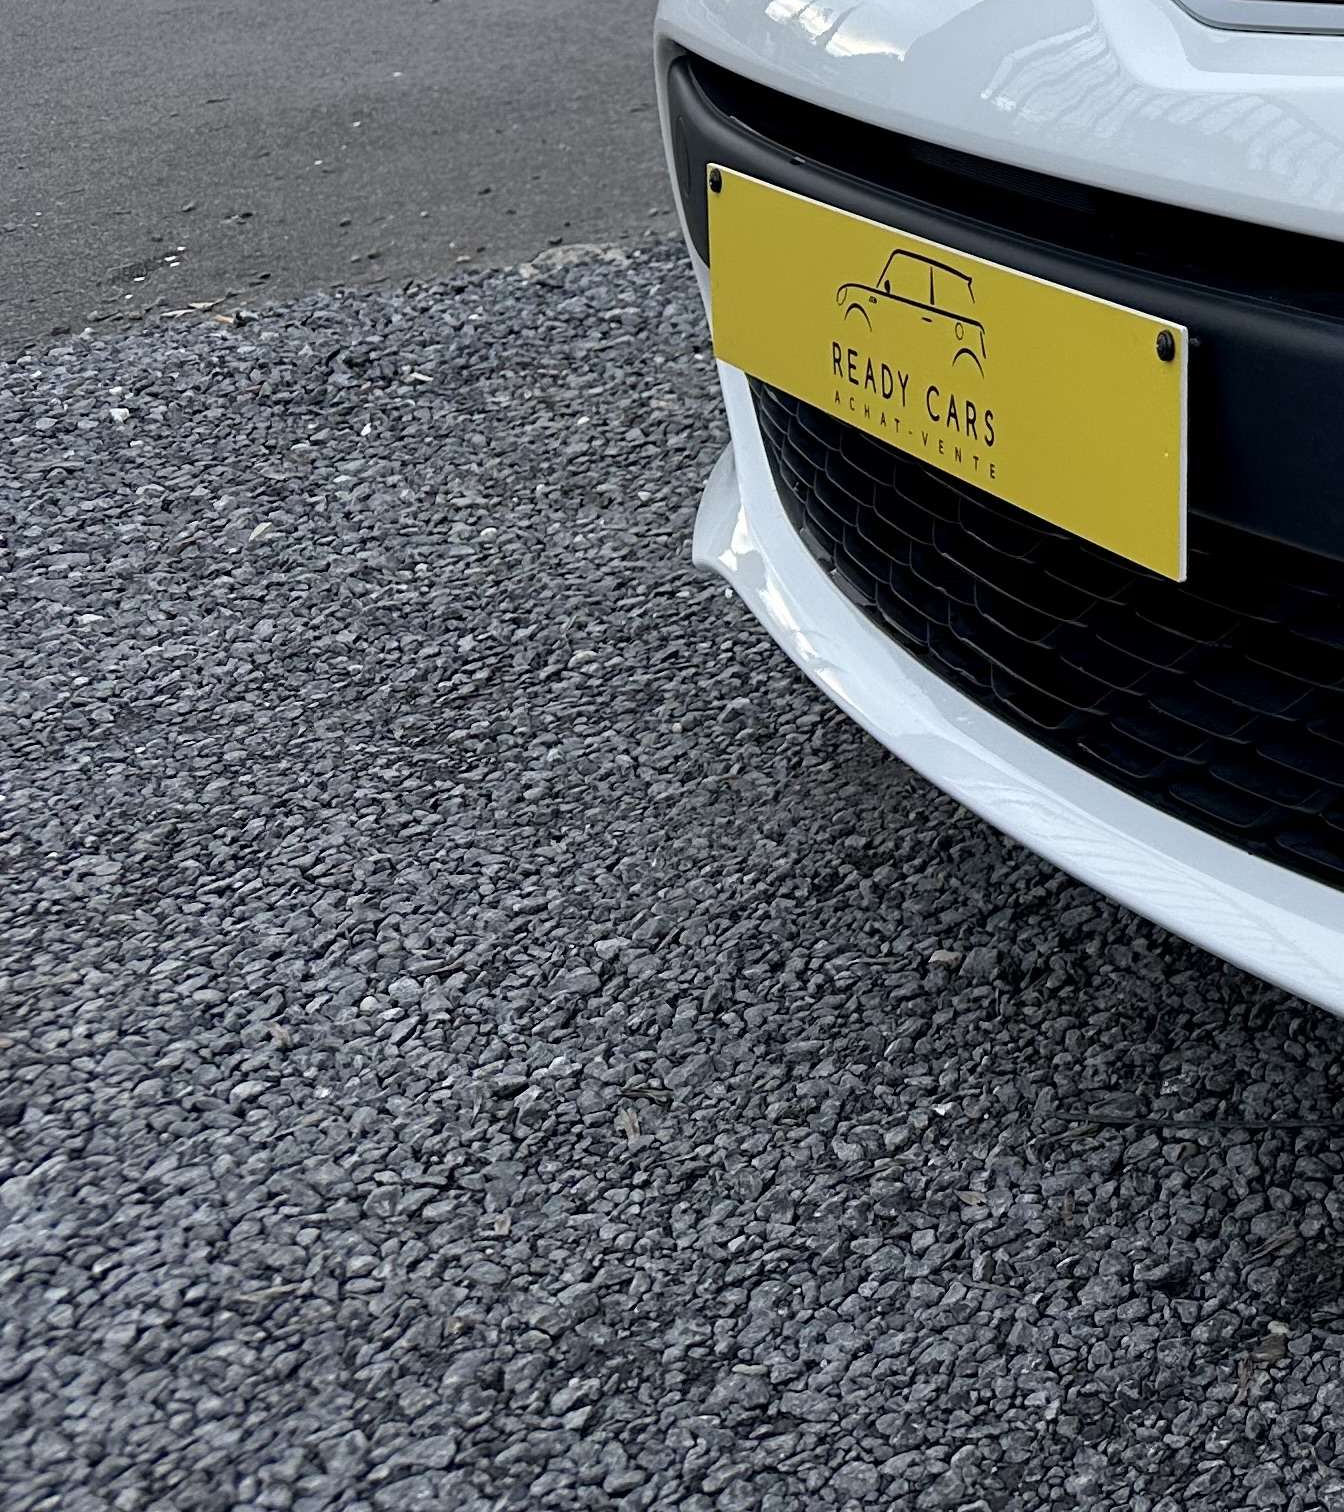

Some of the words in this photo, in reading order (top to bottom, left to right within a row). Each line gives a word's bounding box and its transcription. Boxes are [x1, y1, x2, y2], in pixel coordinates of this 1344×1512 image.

[832, 341, 909, 408] READY
[926, 385, 996, 447] CARS
[834, 390, 996, 480] ACHAT-VENTE
